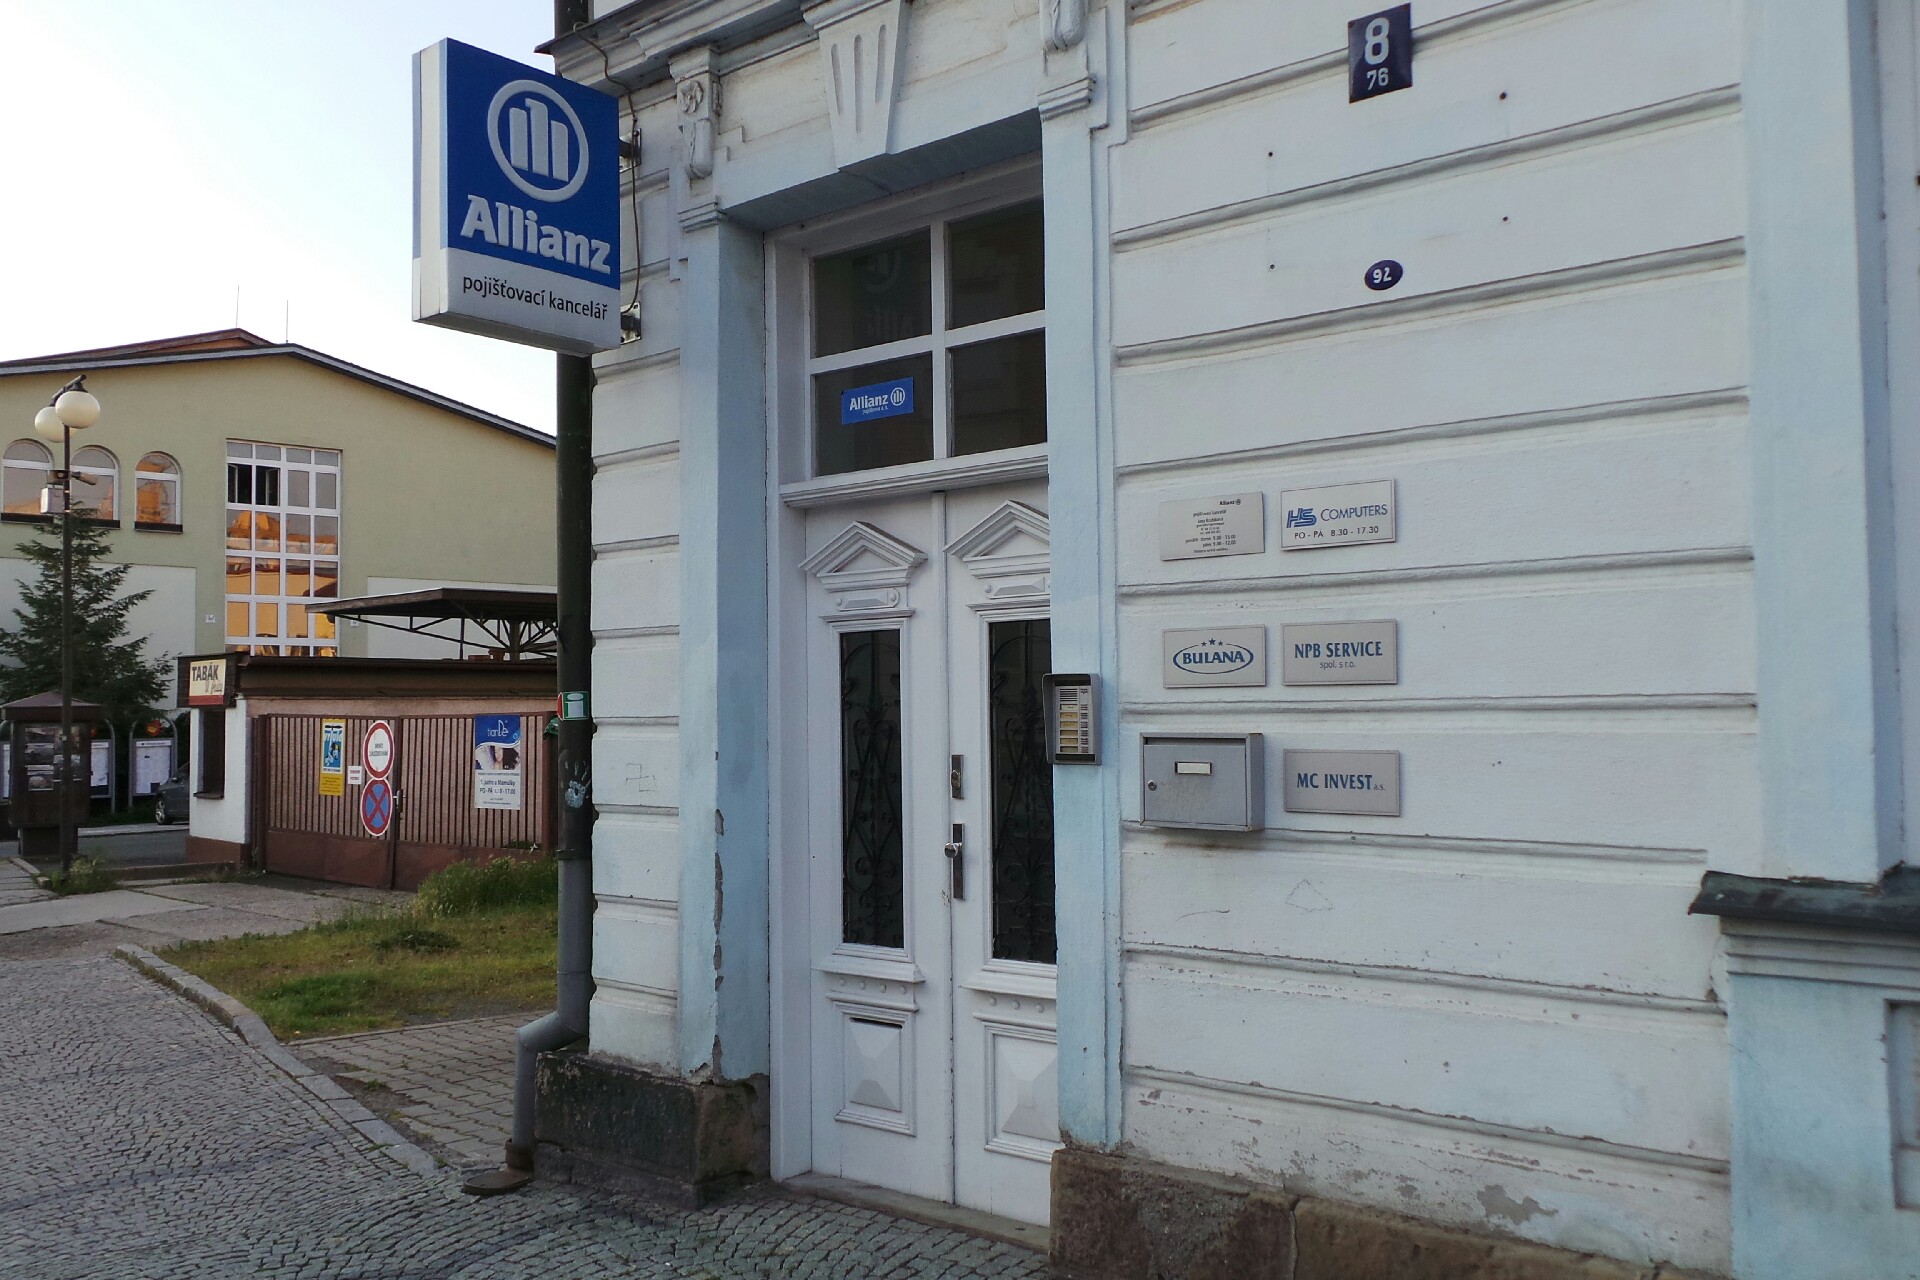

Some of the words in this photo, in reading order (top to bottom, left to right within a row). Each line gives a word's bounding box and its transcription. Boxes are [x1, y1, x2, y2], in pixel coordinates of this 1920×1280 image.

[1365, 17, 1390, 66] 8
[1366, 67, 1389, 91] 76
[460, 194, 611, 275] Allianz
[1372, 266, 1392, 284] 92
[462, 275, 546, 307] pojišťovací
[549, 290, 608, 321] kancelář
[849, 394, 889, 411] Allianz
[1286, 507, 1318, 529] HS
[1320, 504, 1389, 522] COMPUTERS
[1294, 531, 1306, 540] PO
[1330, 528, 1348, 537] 8.30
[1357, 525, 1379, 535] 17.30
[1182, 650, 1246, 665] BULANA
[1294, 643, 1321, 659] NPB
[1326, 641, 1383, 658] SERVICE
[192, 662, 219, 682] TABÁK
[1319, 660, 1337, 670] spol.
[1297, 773, 1319, 788] MC
[1324, 773, 1373, 790] INVEST
